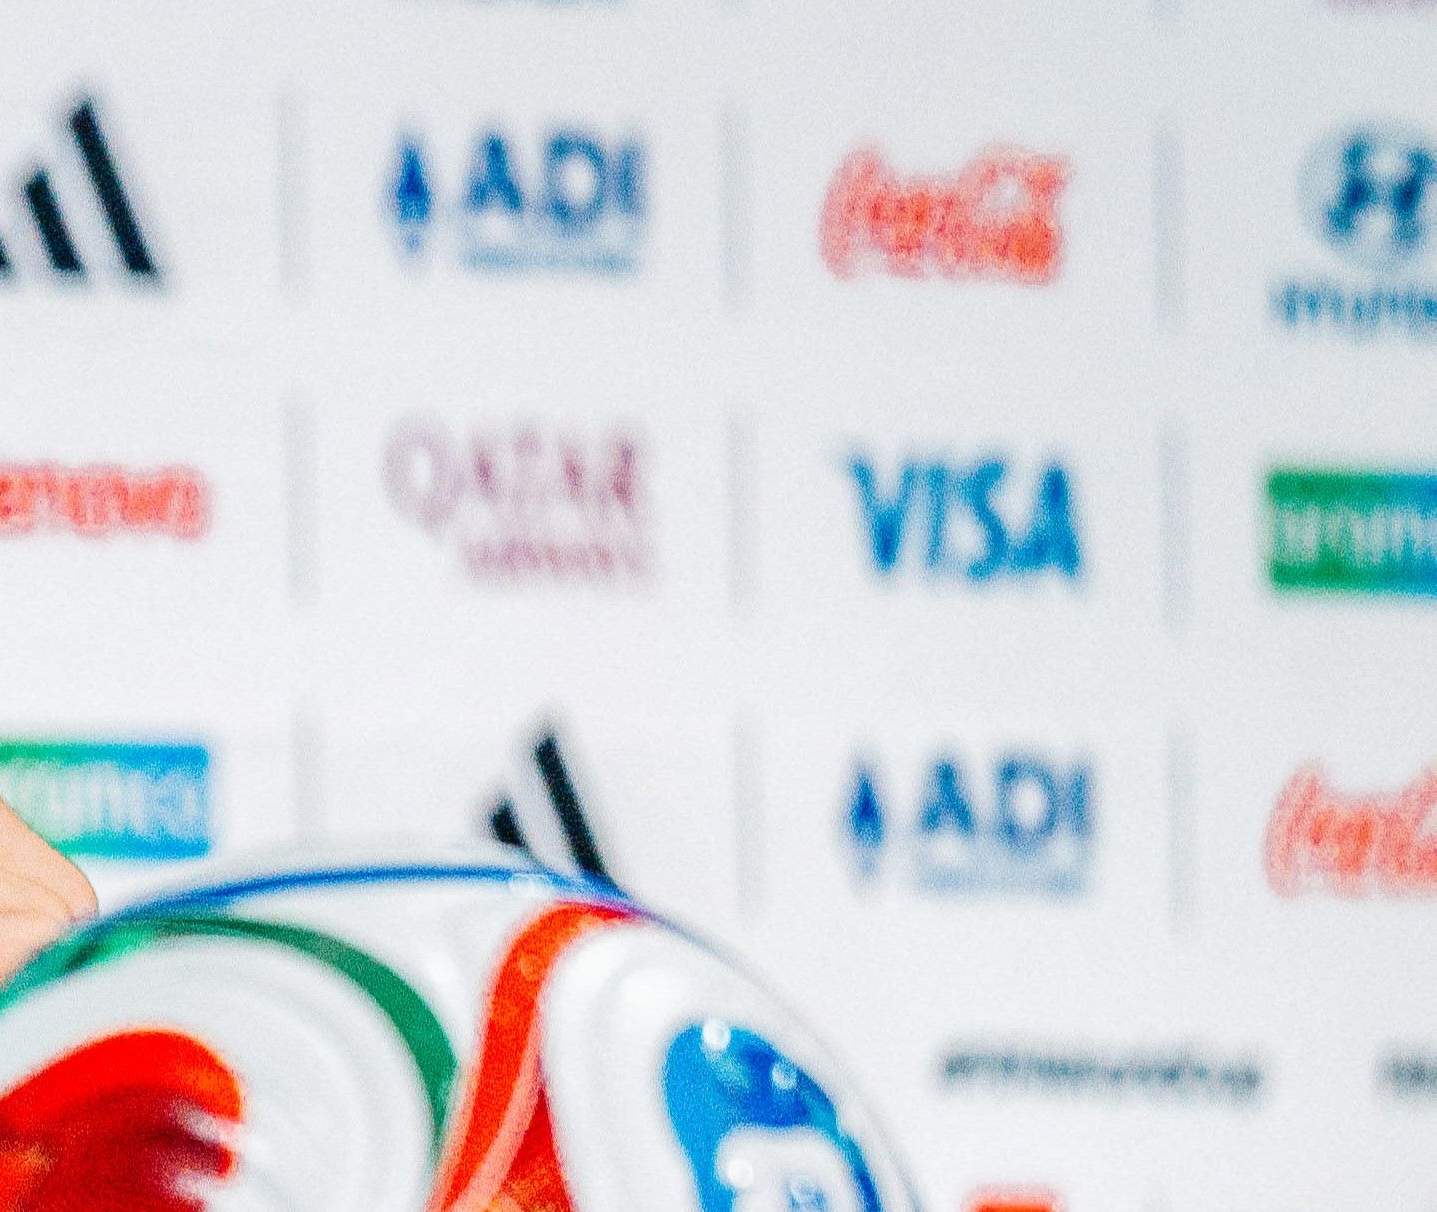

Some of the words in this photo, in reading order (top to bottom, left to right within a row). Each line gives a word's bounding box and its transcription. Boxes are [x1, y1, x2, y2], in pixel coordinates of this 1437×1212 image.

[464, 128, 642, 230] ADI
[843, 445, 1085, 584] VISA
[917, 746, 1093, 853] ADI
